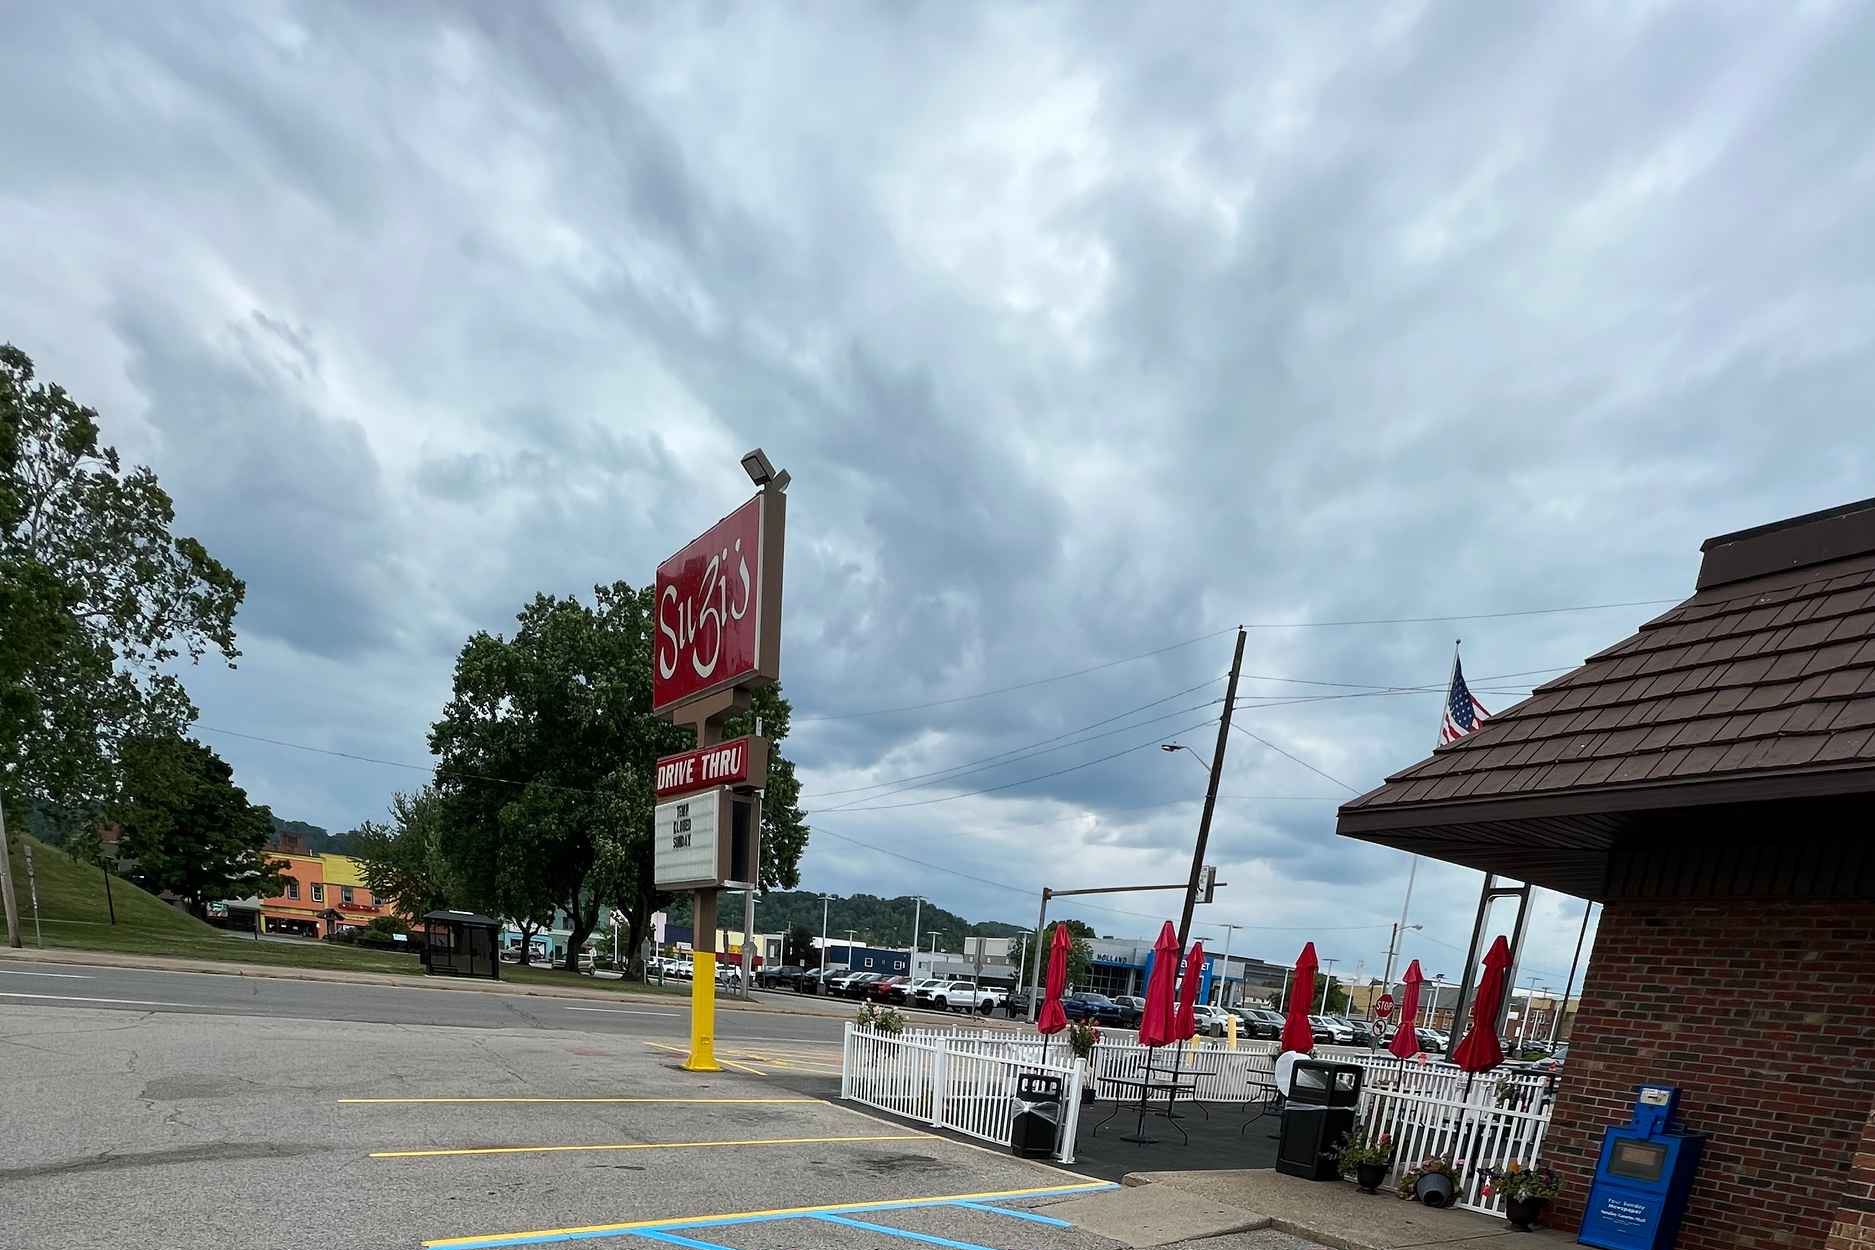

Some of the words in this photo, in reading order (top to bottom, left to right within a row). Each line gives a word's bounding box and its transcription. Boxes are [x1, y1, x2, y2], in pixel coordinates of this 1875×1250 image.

[657, 758, 696, 790] DRIVE
[701, 746, 742, 781] THRU
[1376, 1000, 1393, 1011] STOP
